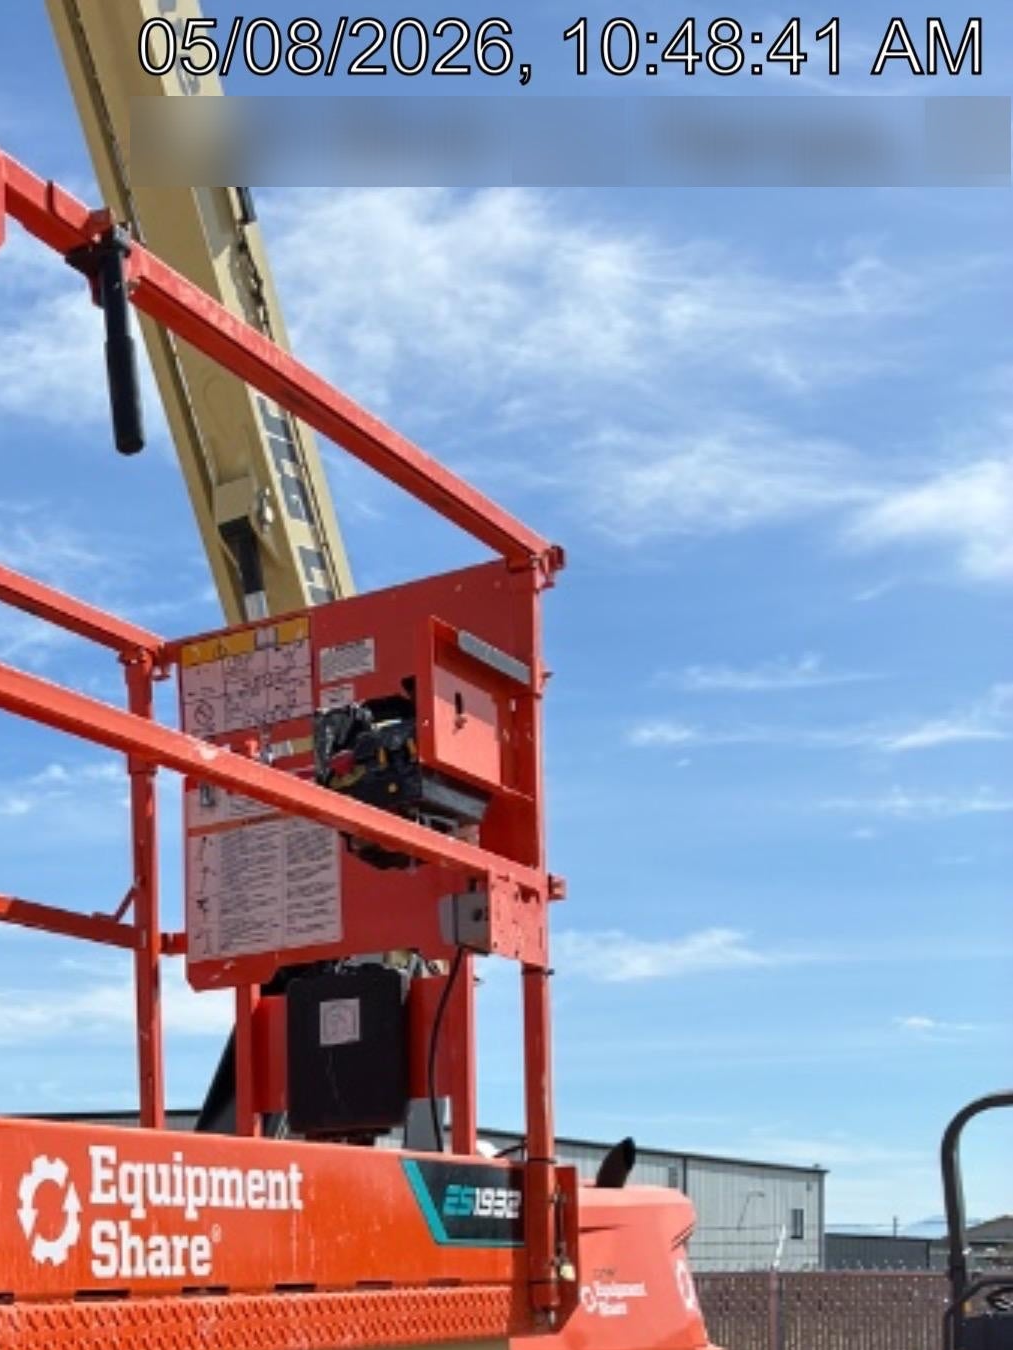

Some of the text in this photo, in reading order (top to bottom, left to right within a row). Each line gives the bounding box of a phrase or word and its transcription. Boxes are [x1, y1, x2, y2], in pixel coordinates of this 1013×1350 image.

[89, 1145, 303, 1219] Equipment
[443, 1184, 522, 1218] ES1932
[91, 1219, 212, 1278] Share
